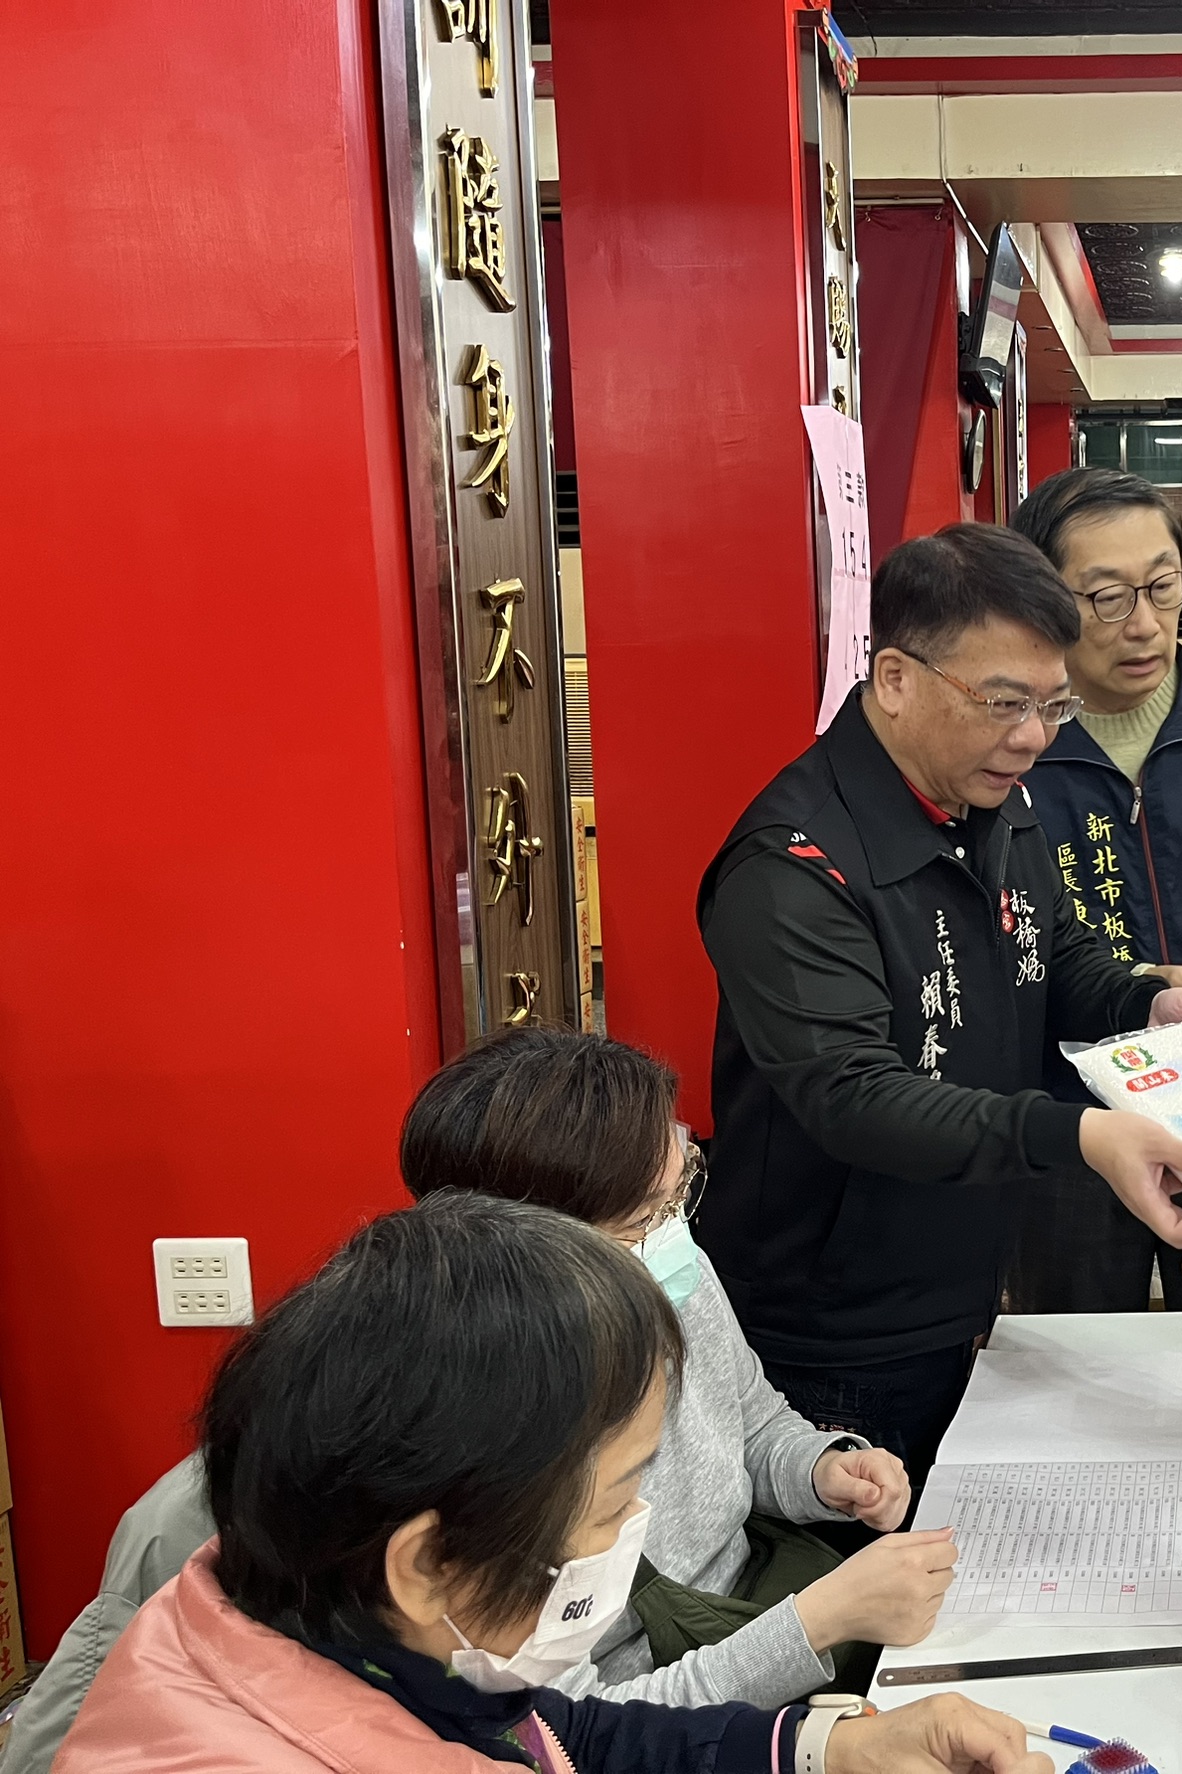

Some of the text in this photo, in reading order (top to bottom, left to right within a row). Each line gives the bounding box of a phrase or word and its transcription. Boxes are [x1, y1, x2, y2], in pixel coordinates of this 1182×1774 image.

[935, 909, 964, 1030] 主任委員
[1009, 888, 1046, 987] 板橋媽
